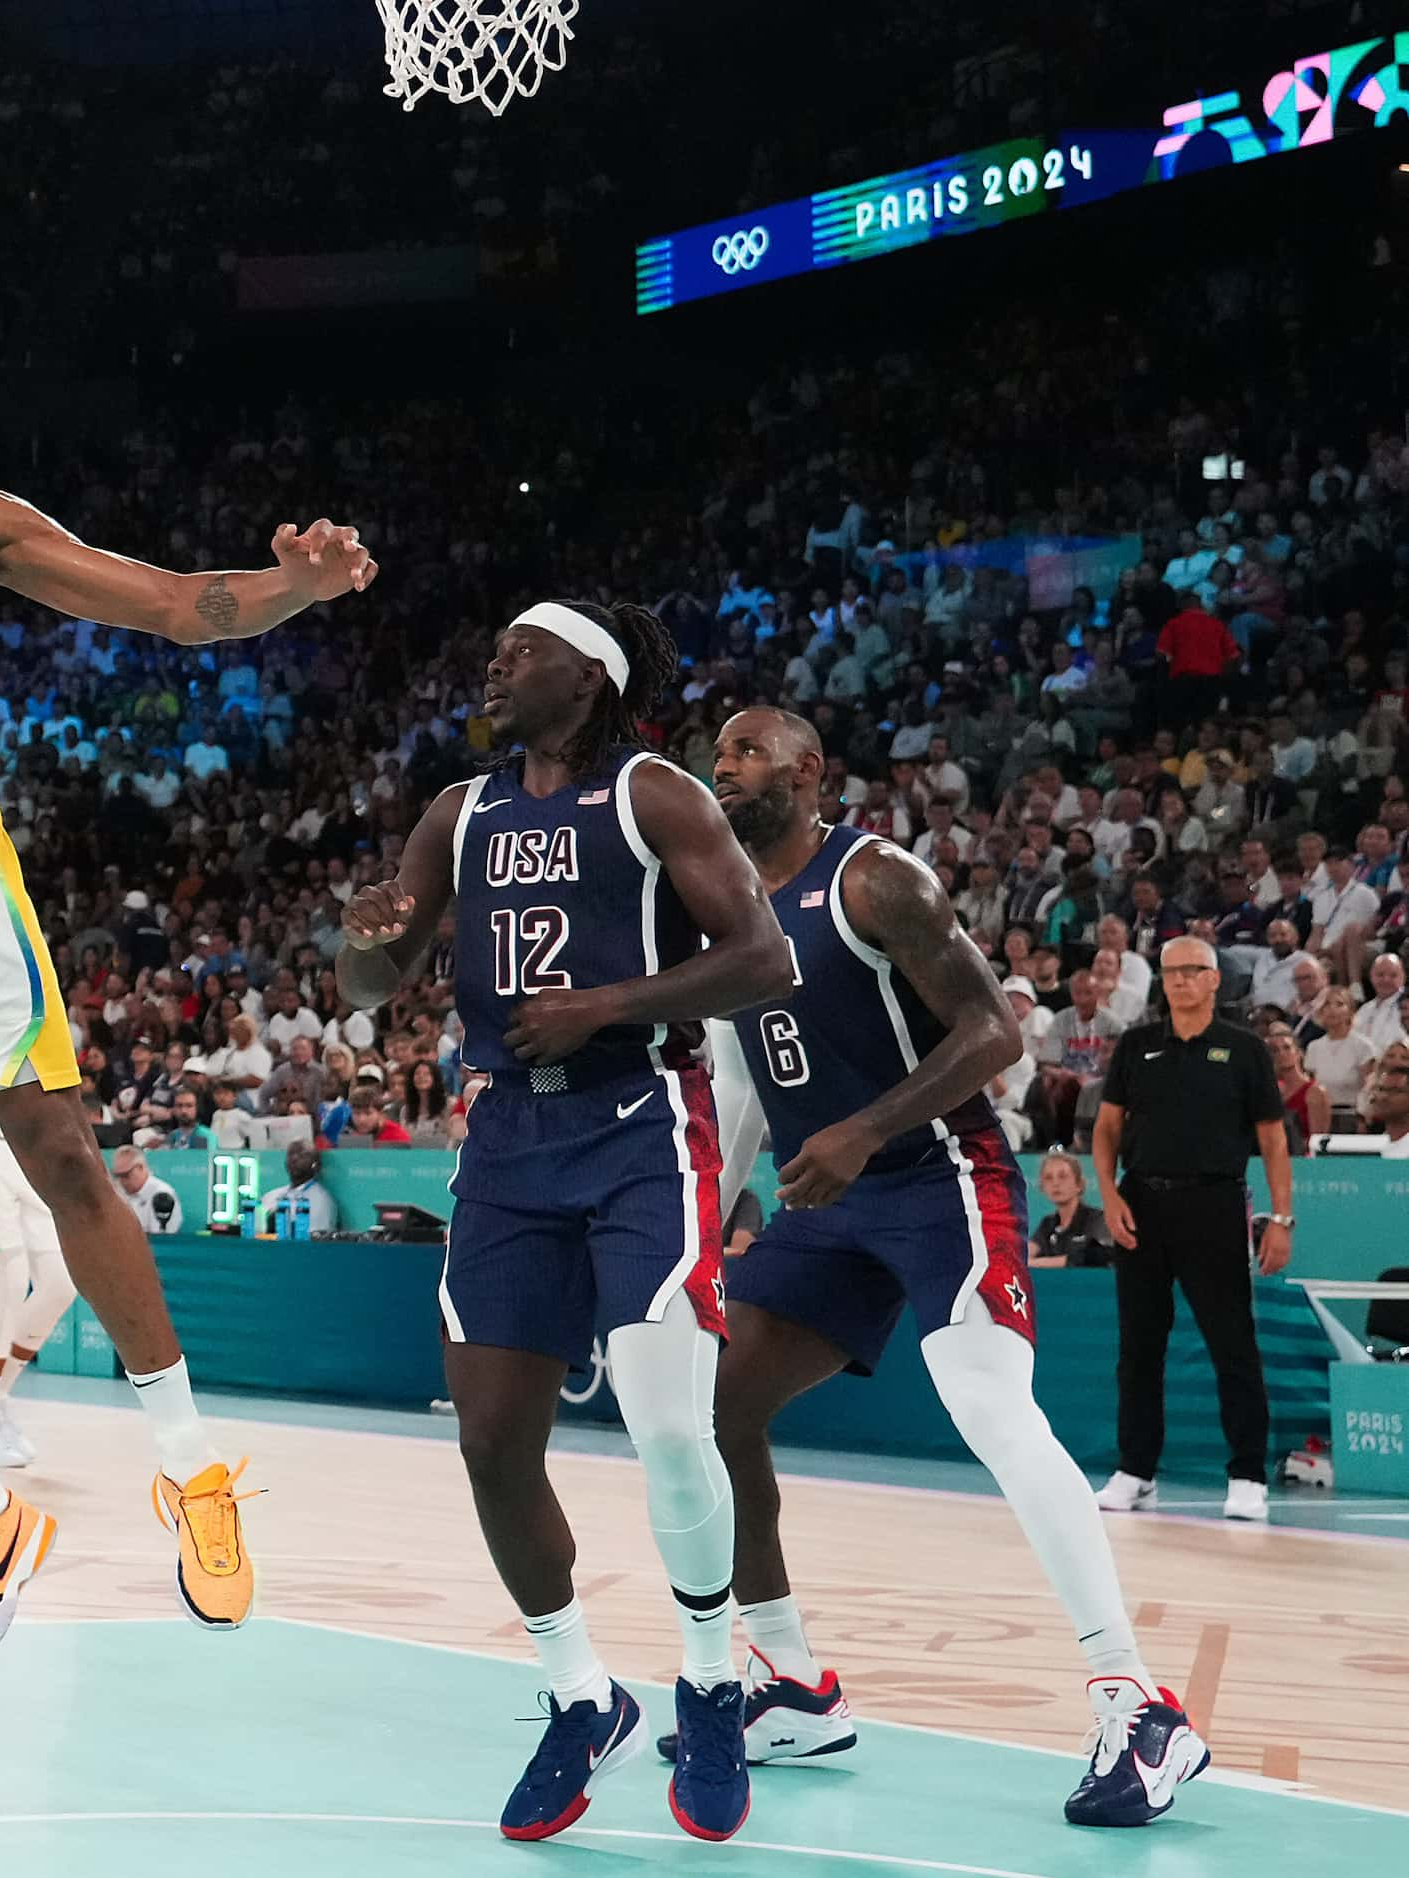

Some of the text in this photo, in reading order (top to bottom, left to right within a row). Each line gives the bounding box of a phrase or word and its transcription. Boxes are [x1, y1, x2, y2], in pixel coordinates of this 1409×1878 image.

[855, 145, 1091, 238] PARIS 2024
[486, 826, 580, 888] USA
[491, 905, 572, 997] 12
[759, 1009, 810, 1087] 6
[1346, 1411, 1403, 1434] PARIS
[1348, 1432, 1403, 1455] 2024
